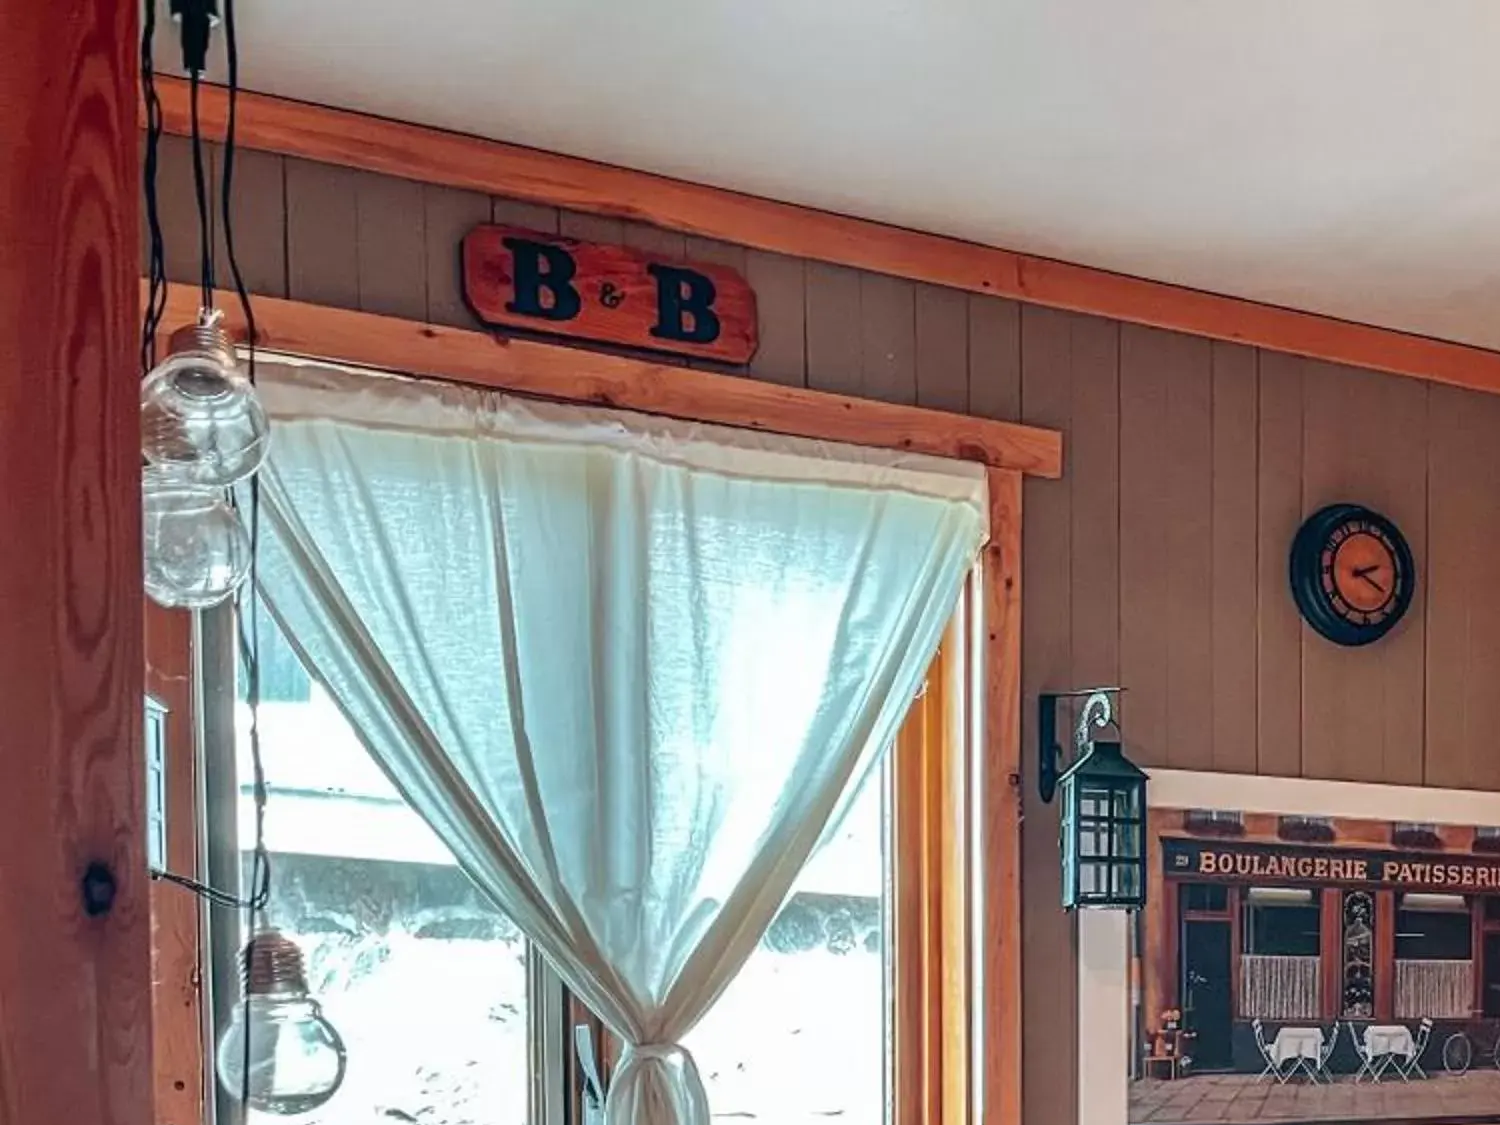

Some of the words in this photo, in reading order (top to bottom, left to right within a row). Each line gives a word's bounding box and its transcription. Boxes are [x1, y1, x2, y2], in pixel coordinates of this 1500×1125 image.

[502, 237, 582, 321] B
[600, 282, 626, 309] &
[647, 262, 721, 344] B
[1199, 851, 1367, 880] BOULANGERIE
